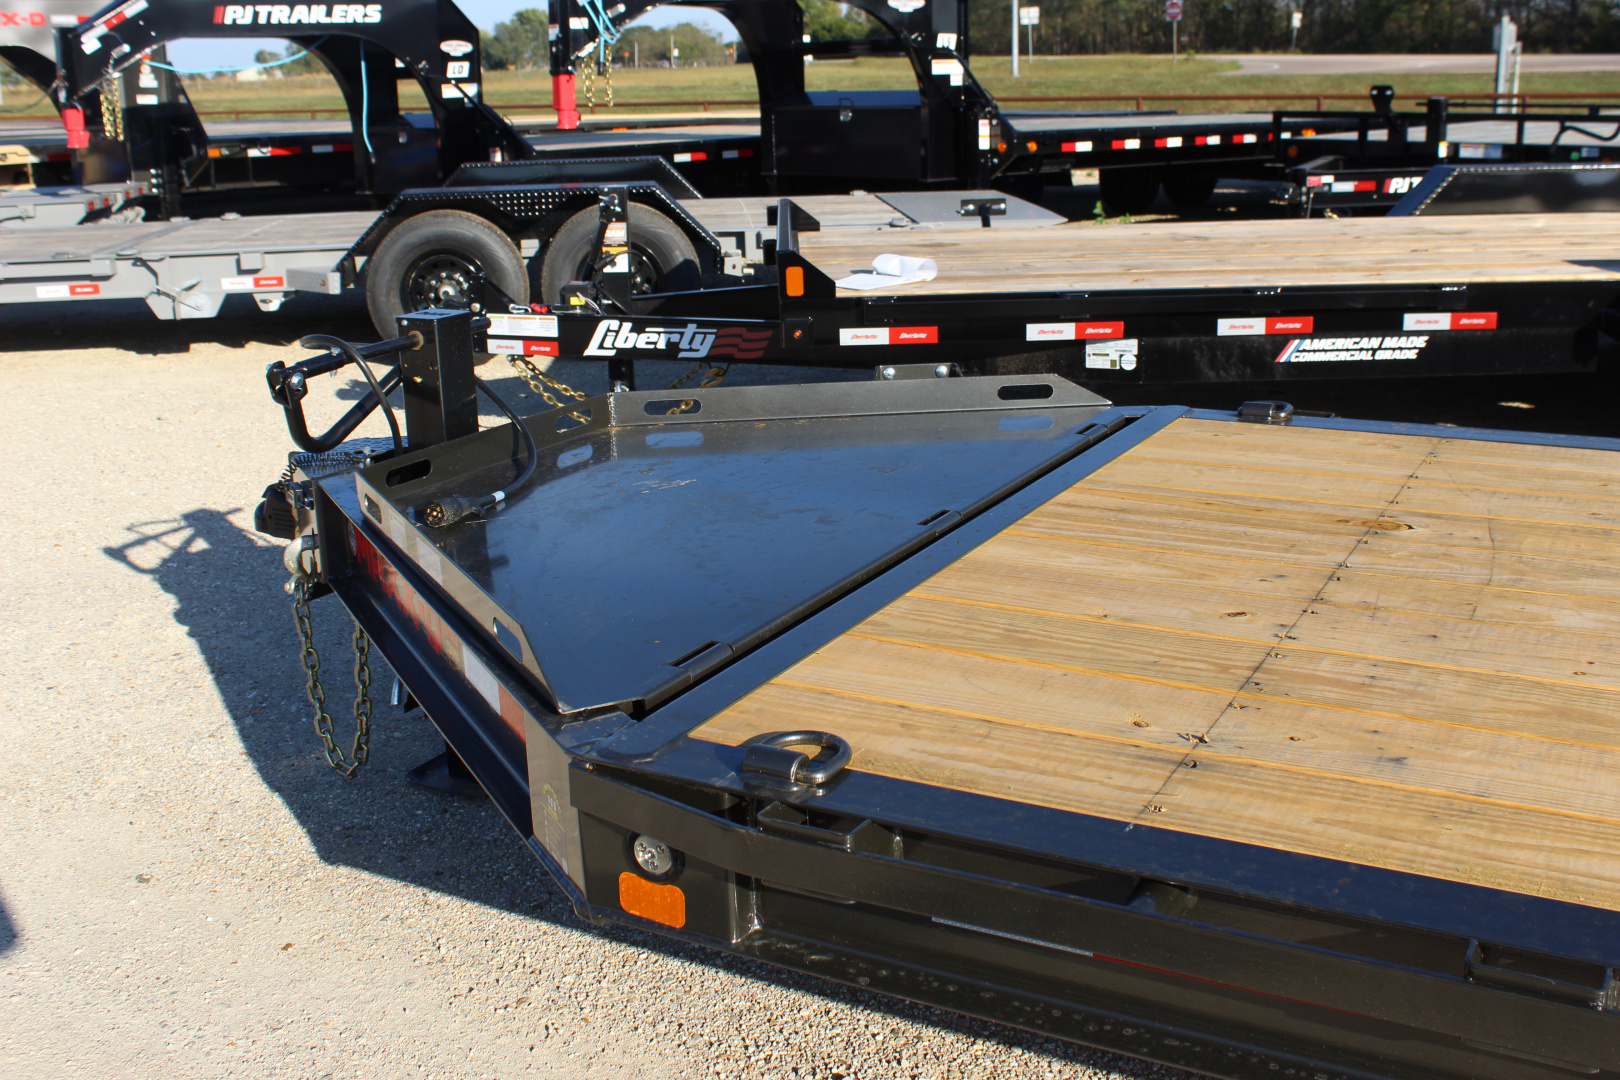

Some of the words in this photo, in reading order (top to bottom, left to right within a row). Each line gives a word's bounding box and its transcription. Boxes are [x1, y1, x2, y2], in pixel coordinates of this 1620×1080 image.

[223, 5, 254, 25] PJ
[255, 4, 382, 25] TRAILERS
[583, 319, 718, 359] Liberty
[1298, 336, 1383, 351] AMERICAN
[1381, 335, 1430, 349] MADE
[1289, 349, 1374, 363] COMMERCIAL
[1374, 348, 1420, 361] GRADE
